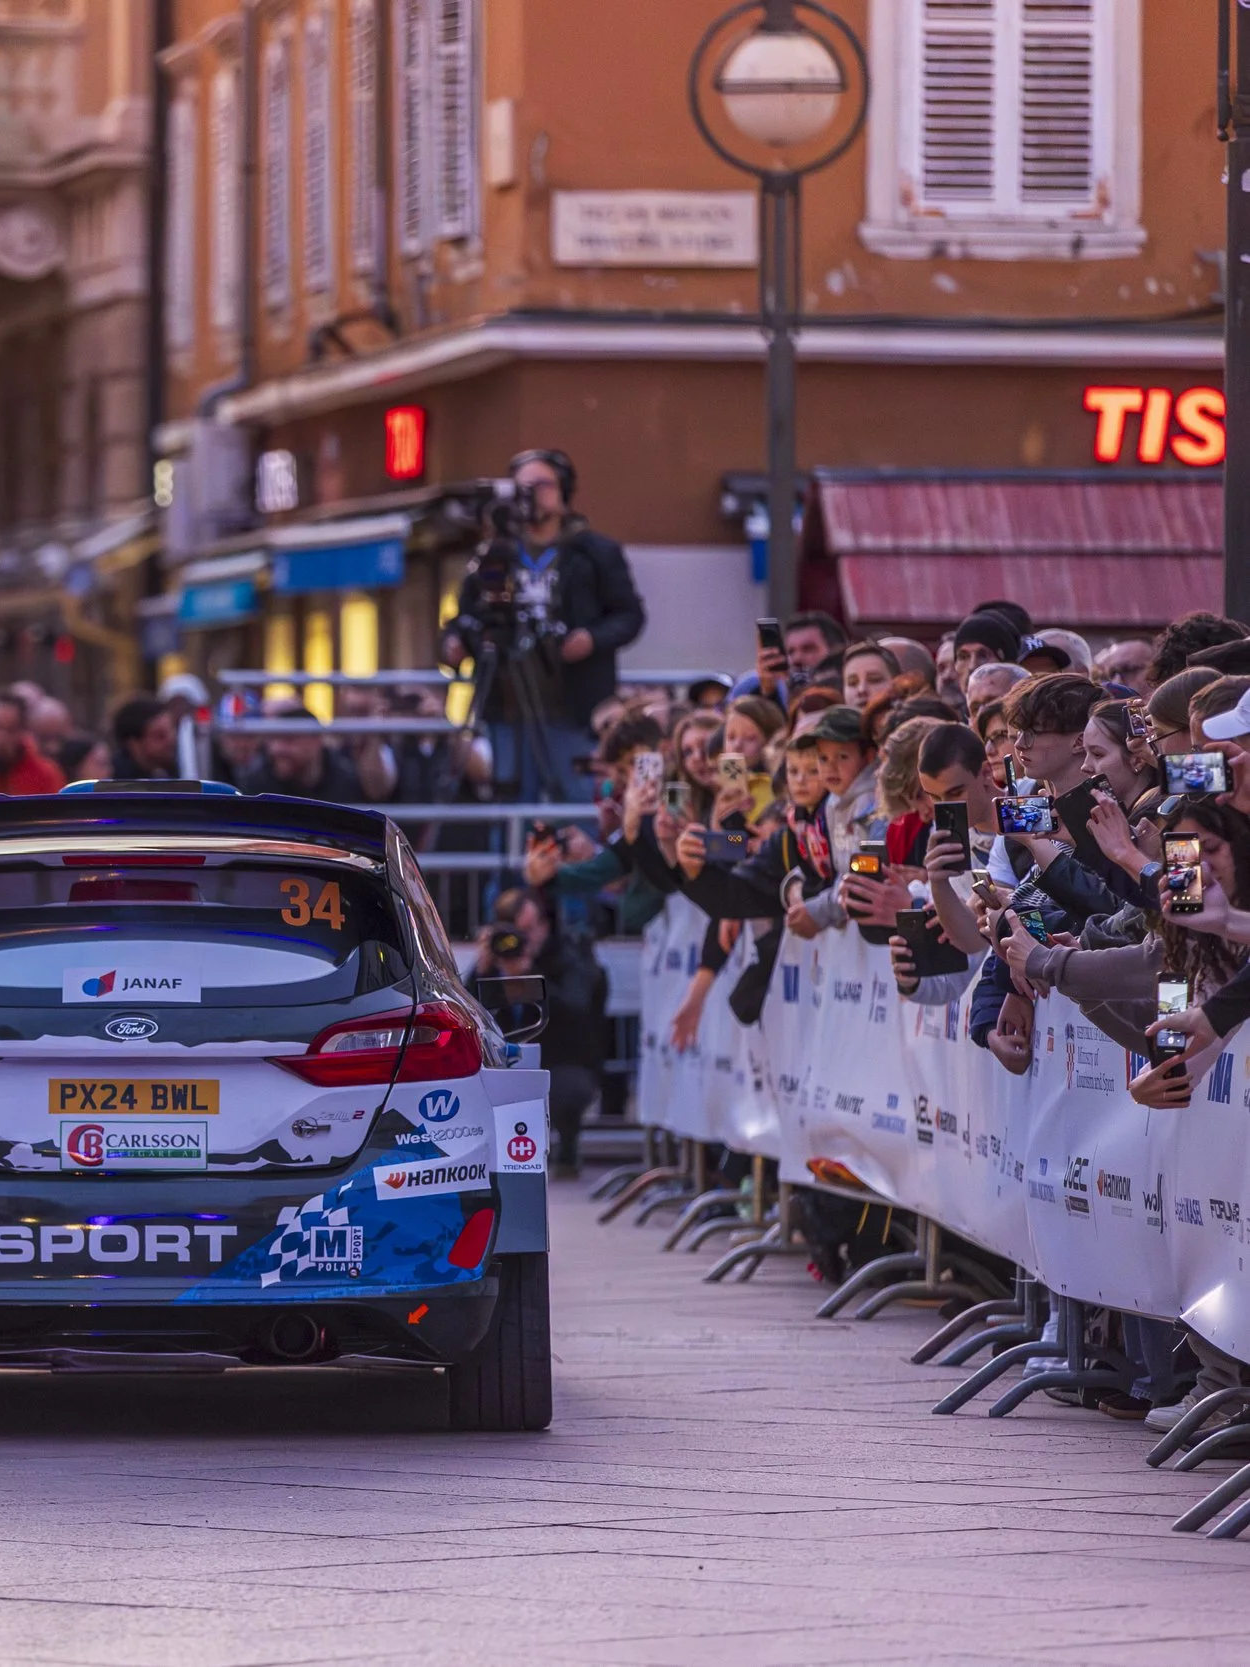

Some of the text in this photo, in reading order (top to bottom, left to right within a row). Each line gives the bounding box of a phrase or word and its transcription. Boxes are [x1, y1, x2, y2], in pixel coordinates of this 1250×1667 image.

[1083, 385, 1226, 467] TIS
[279, 879, 345, 930] 34
[122, 978, 182, 991] JANAF
[117, 1022, 145, 1035] Ford
[60, 1084, 208, 1111] PX24 BWL
[352, 1110, 365, 1120] 2
[106, 1134, 200, 1147] CARLSSON
[395, 1126, 484, 1146] West2000.se
[315, 1229, 347, 1258] M
[353, 1228, 362, 1260] SPORT
[318, 1262, 362, 1272] POLAND
